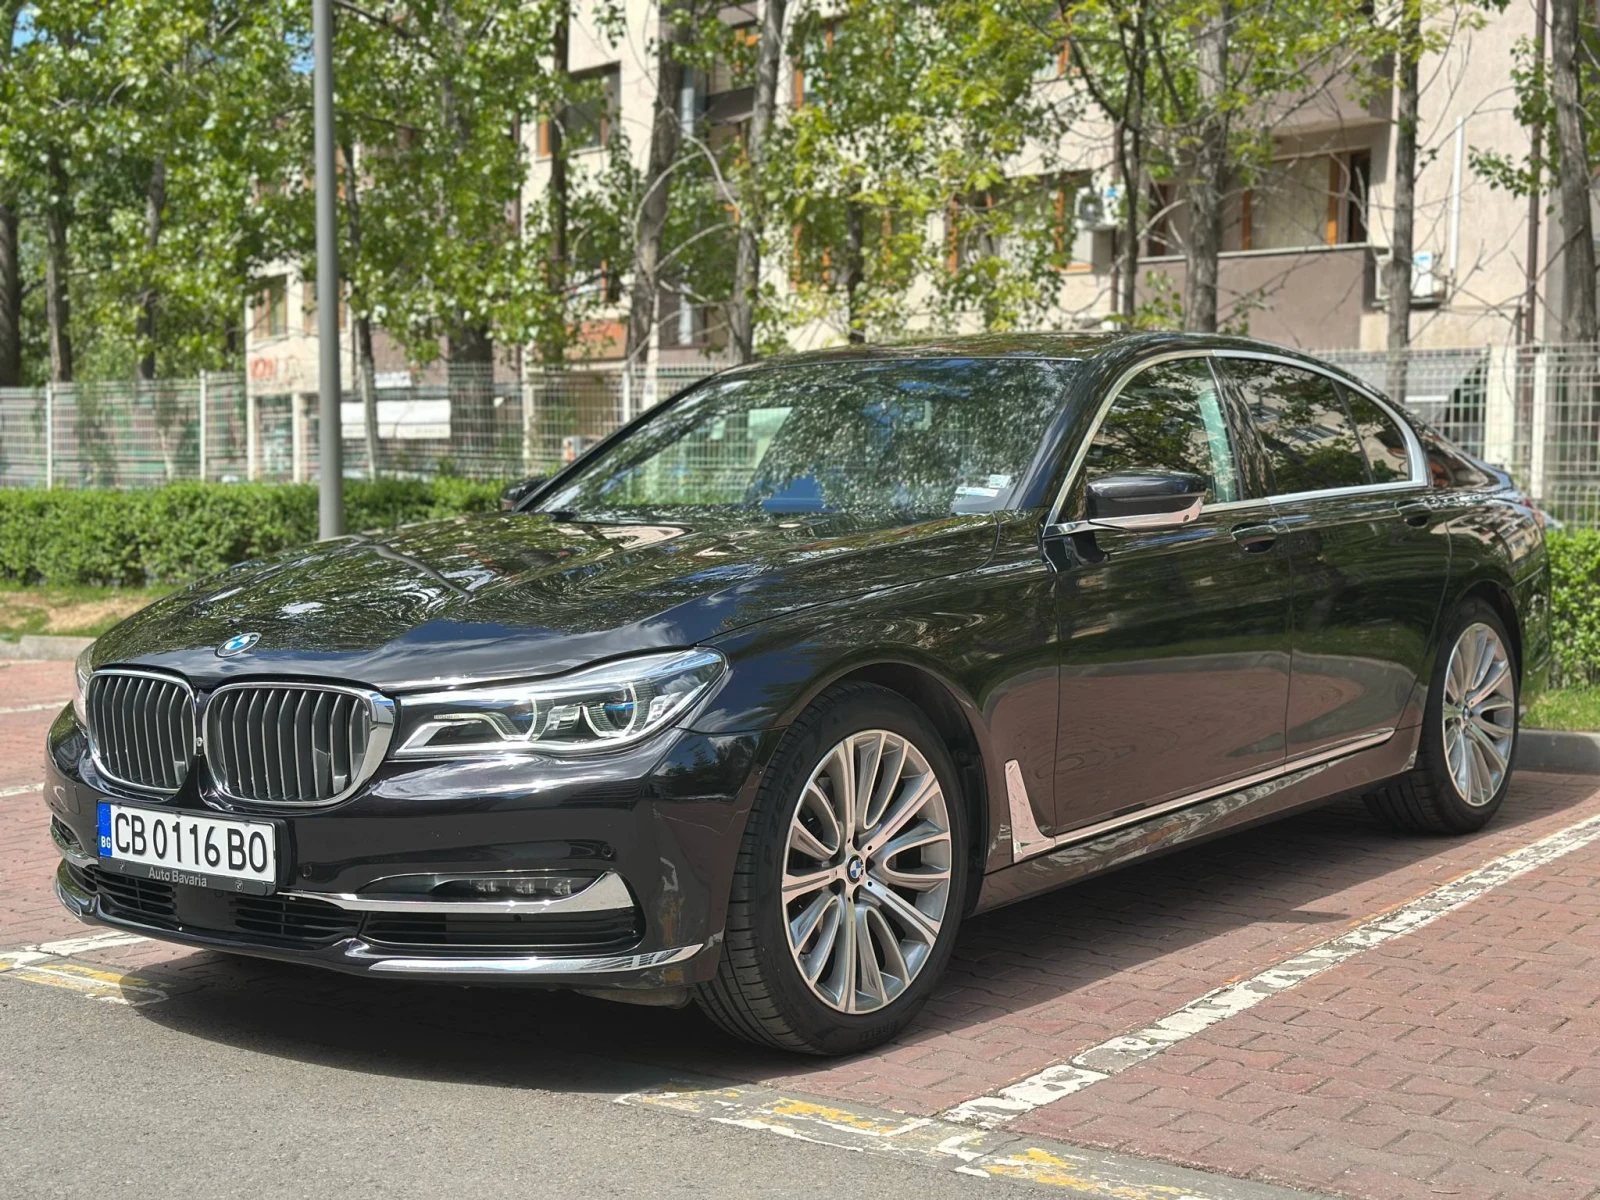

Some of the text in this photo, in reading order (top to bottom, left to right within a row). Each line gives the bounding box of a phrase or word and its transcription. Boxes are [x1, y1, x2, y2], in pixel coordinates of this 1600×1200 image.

[101, 835, 112, 849] BG
[115, 812, 147, 856] CB
[153, 819, 221, 868] 0116
[148, 866, 208, 888] Auto Bavaria
